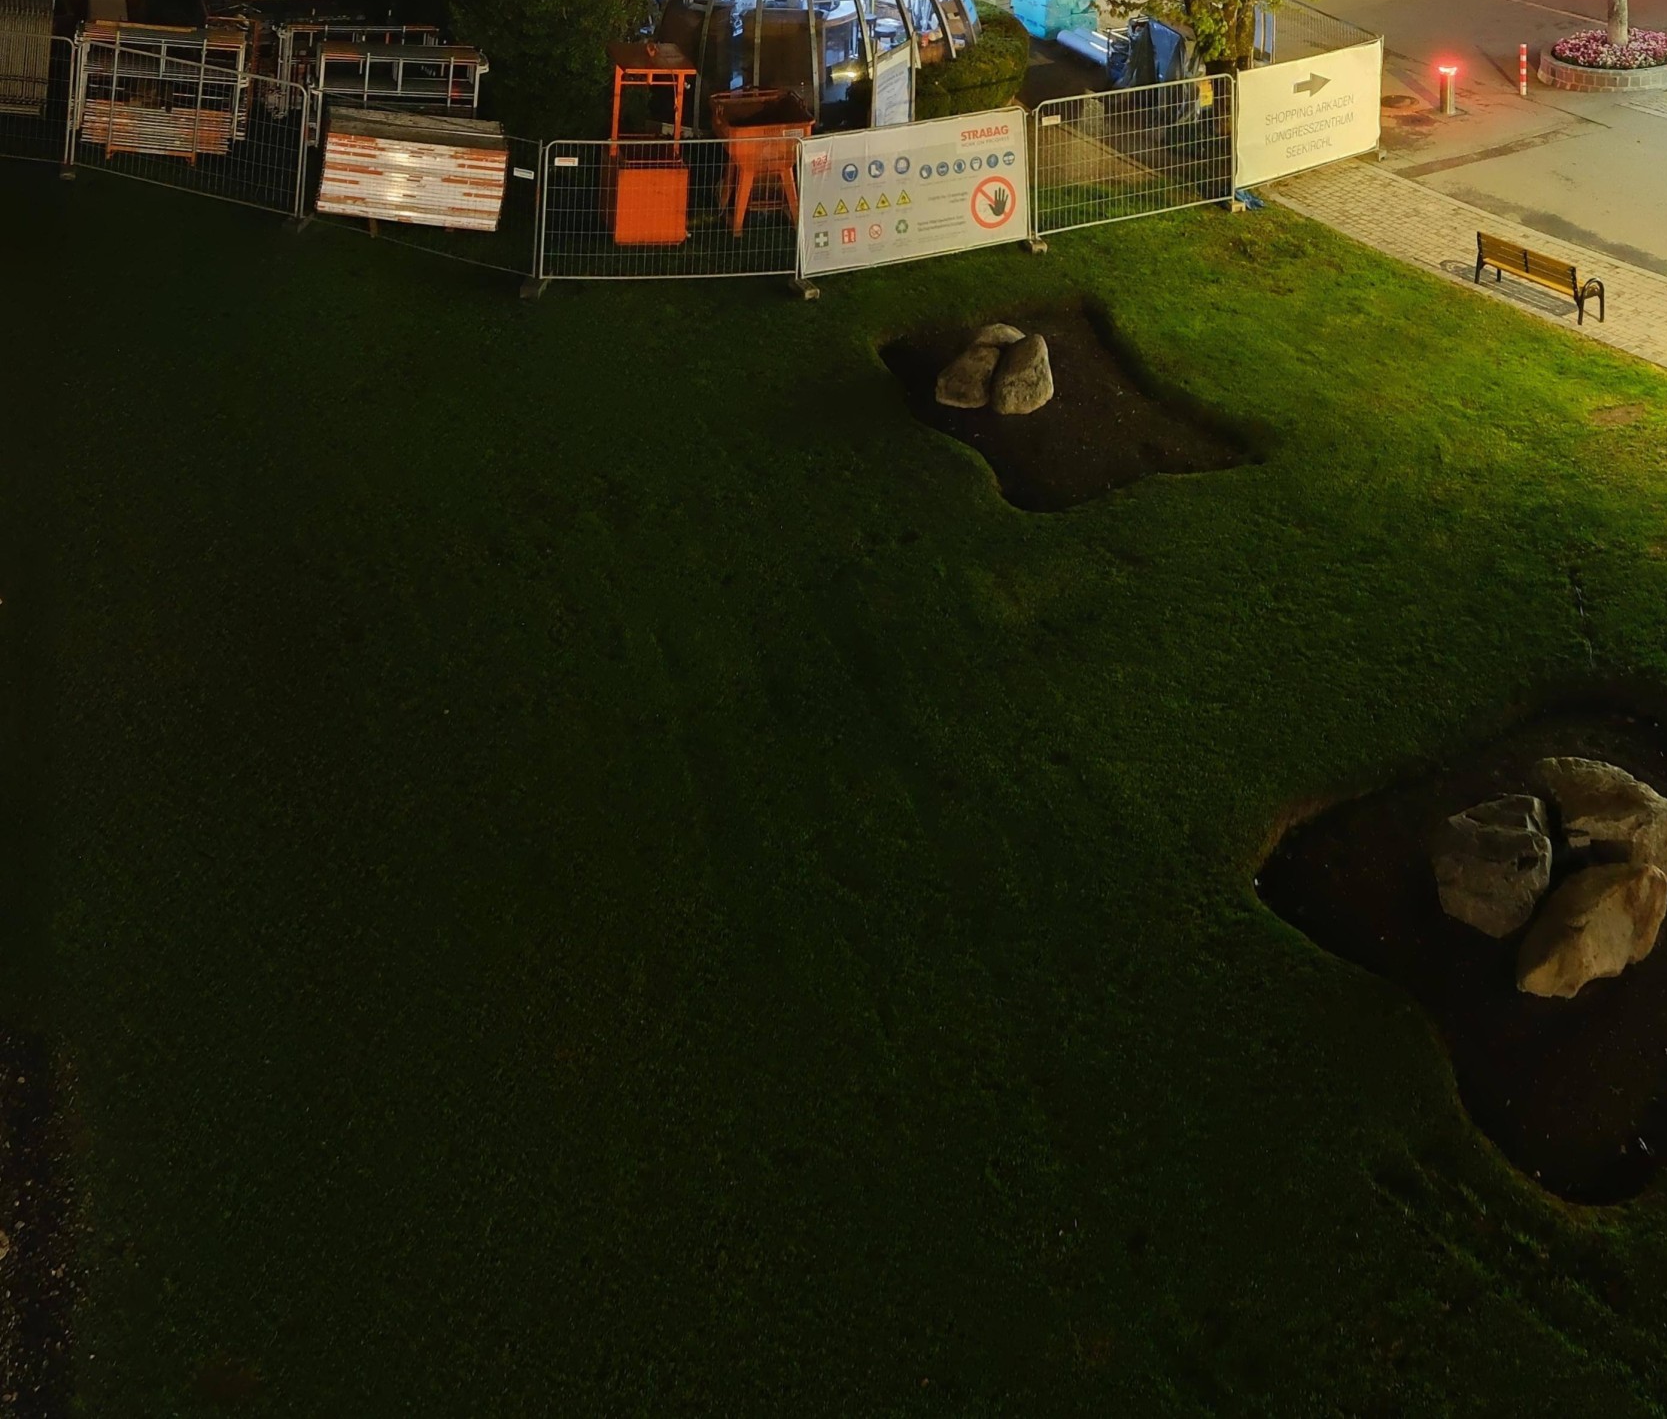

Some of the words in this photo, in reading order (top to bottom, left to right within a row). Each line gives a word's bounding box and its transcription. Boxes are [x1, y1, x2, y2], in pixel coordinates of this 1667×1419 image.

[1264, 105, 1314, 127] SHOPPING
[1315, 94, 1354, 113] ARKADEN
[961, 124, 1009, 142] STRABAG
[1264, 111, 1354, 146] KONGRESSZENTRUM
